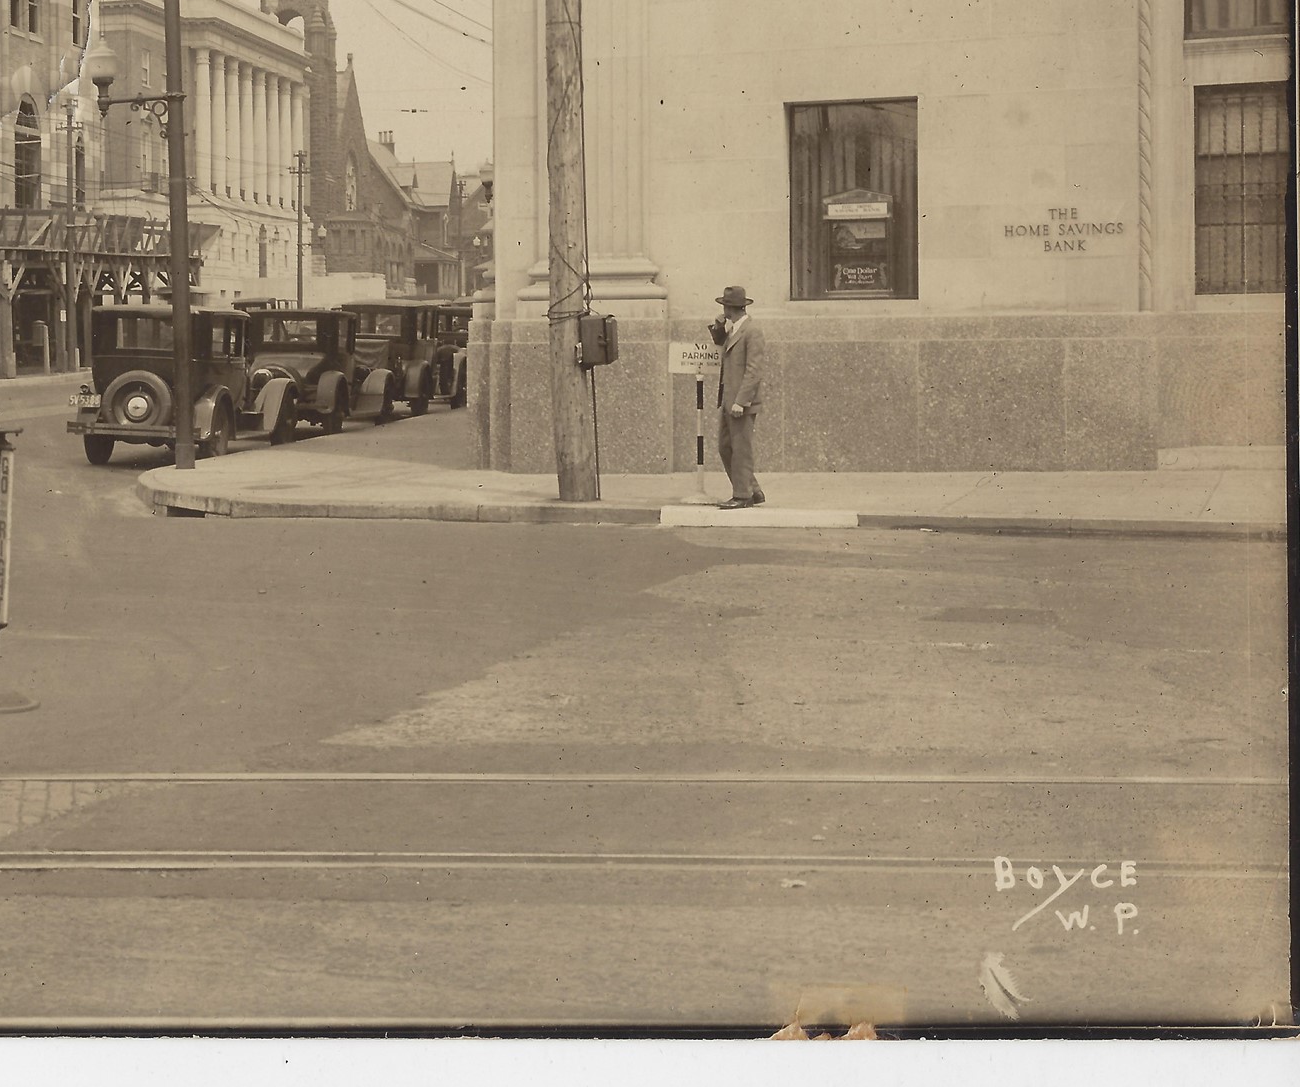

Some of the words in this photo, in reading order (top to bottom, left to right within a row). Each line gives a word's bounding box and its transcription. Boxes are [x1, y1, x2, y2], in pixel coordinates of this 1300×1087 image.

[1048, 208, 1078, 220] THE
[1004, 225, 1050, 237] HOME
[1058, 222, 1124, 236] SAVINGS
[1044, 240, 1087, 252] BANK
[682, 352, 719, 360] PARKING
[1, 456, 10, 494] GO
